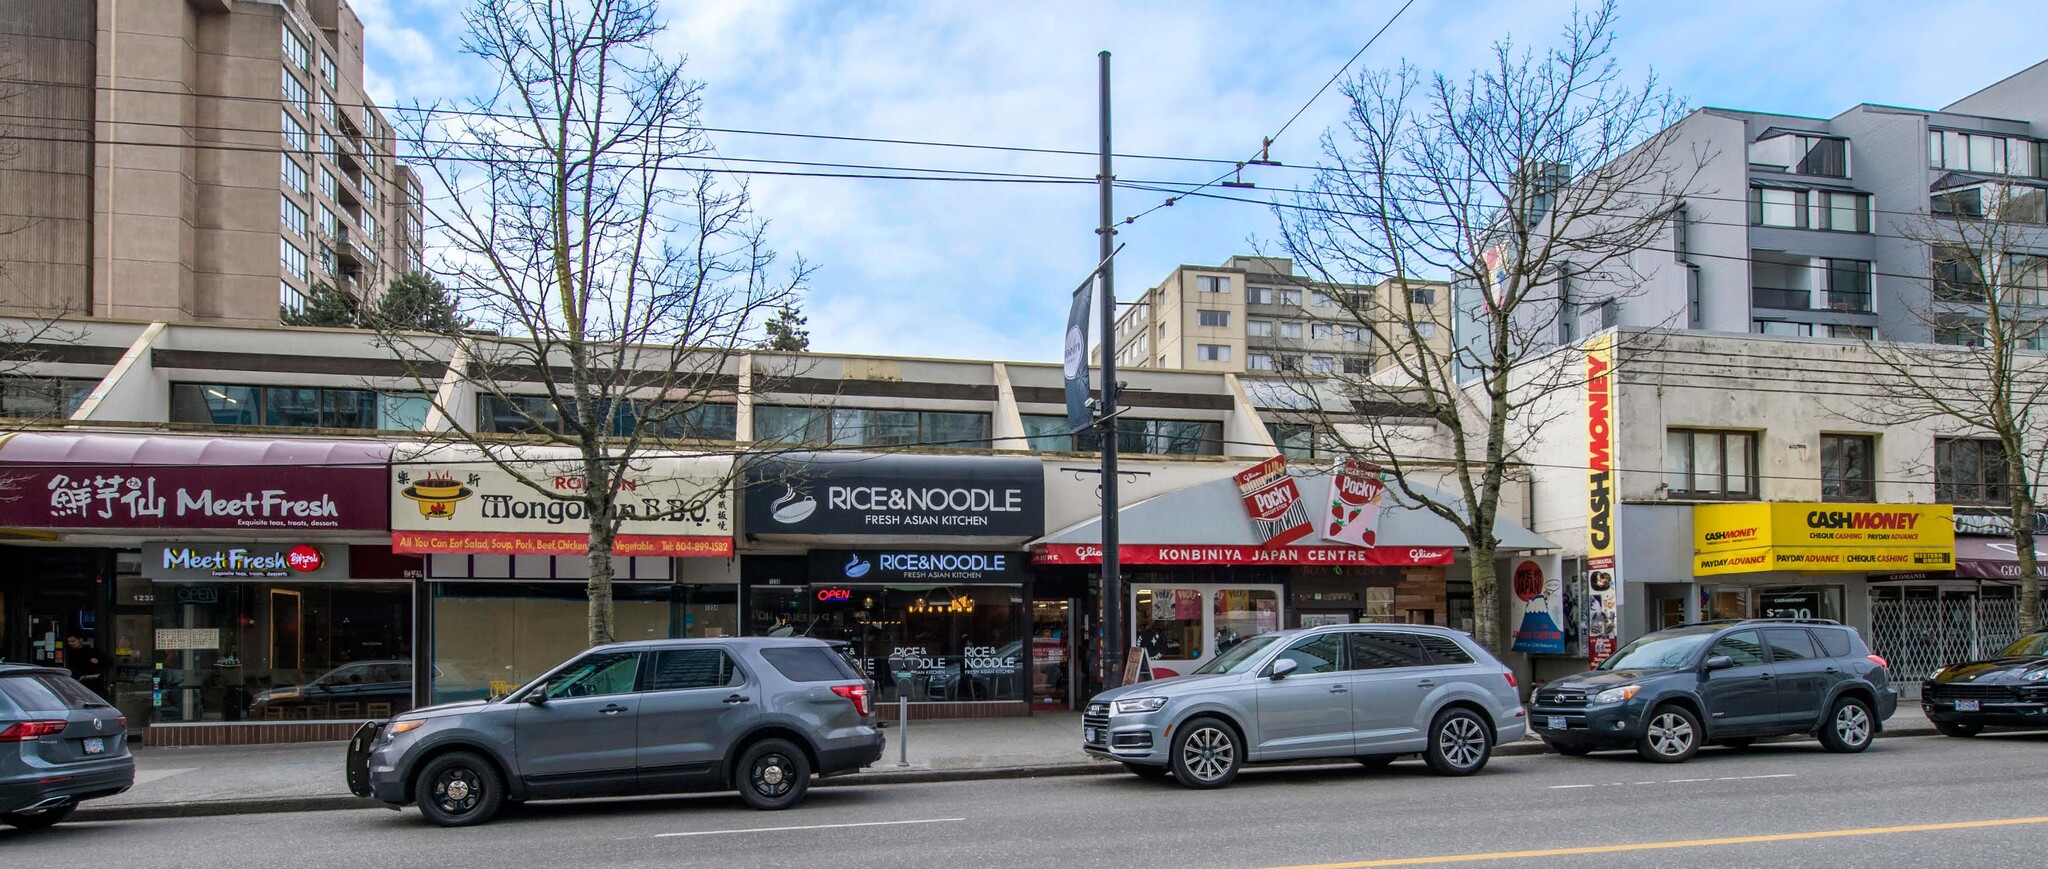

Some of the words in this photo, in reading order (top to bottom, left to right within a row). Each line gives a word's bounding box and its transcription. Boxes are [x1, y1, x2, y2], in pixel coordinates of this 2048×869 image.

[1588, 355, 1610, 550] CASHMONEY
[467, 473, 481, 487] 新
[555, 476, 637, 491] ROON
[48, 474, 166, 518] 鮮芋仙
[828, 486, 1022, 512] RICE&NOODLE
[481, 495, 636, 524] Mongoln
[237, 519, 268, 527] Exquisite
[311, 519, 338, 527] desserts
[865, 515, 900, 525] FRESH
[904, 515, 938, 525] ASIAN
[942, 516, 988, 526] KITCHEN
[1807, 511, 1919, 530] CASHMONEY
[1705, 528, 1758, 541] CASHMONEY
[400, 538, 411, 547] All
[414, 538, 429, 547] You
[431, 538, 447, 547] Can
[450, 539, 463, 547] Eat
[465, 538, 489, 550] Salad,
[492, 538, 513, 550] Soup,
[516, 539, 535, 551] Pork,
[662, 542, 674, 551] Tel:
[676, 541, 729, 552] 604-899-1582
[163, 547, 223, 569] Meet
[229, 549, 287, 569] Fresh
[1075, 546, 1102, 560] Glic
[1159, 550, 1242, 560] KONBINIYA
[1252, 550, 1298, 561] JAPAN
[1308, 550, 1366, 561] CENTRE
[1409, 549, 1442, 562] Glico
[1805, 555, 1840, 563] ADVANCE
[1877, 555, 1909, 563] CASHING
[880, 554, 1006, 571] RICE&NOODLE
[1701, 559, 1728, 568] PAYDAY
[1728, 556, 1766, 566] ADVANCE
[2001, 565, 2047, 577] GEONI
[178, 588, 217, 599] OPEN
[817, 589, 850, 601] OPEN
[964, 647, 990, 657] RICE
[964, 658, 1015, 668] NOODLE
